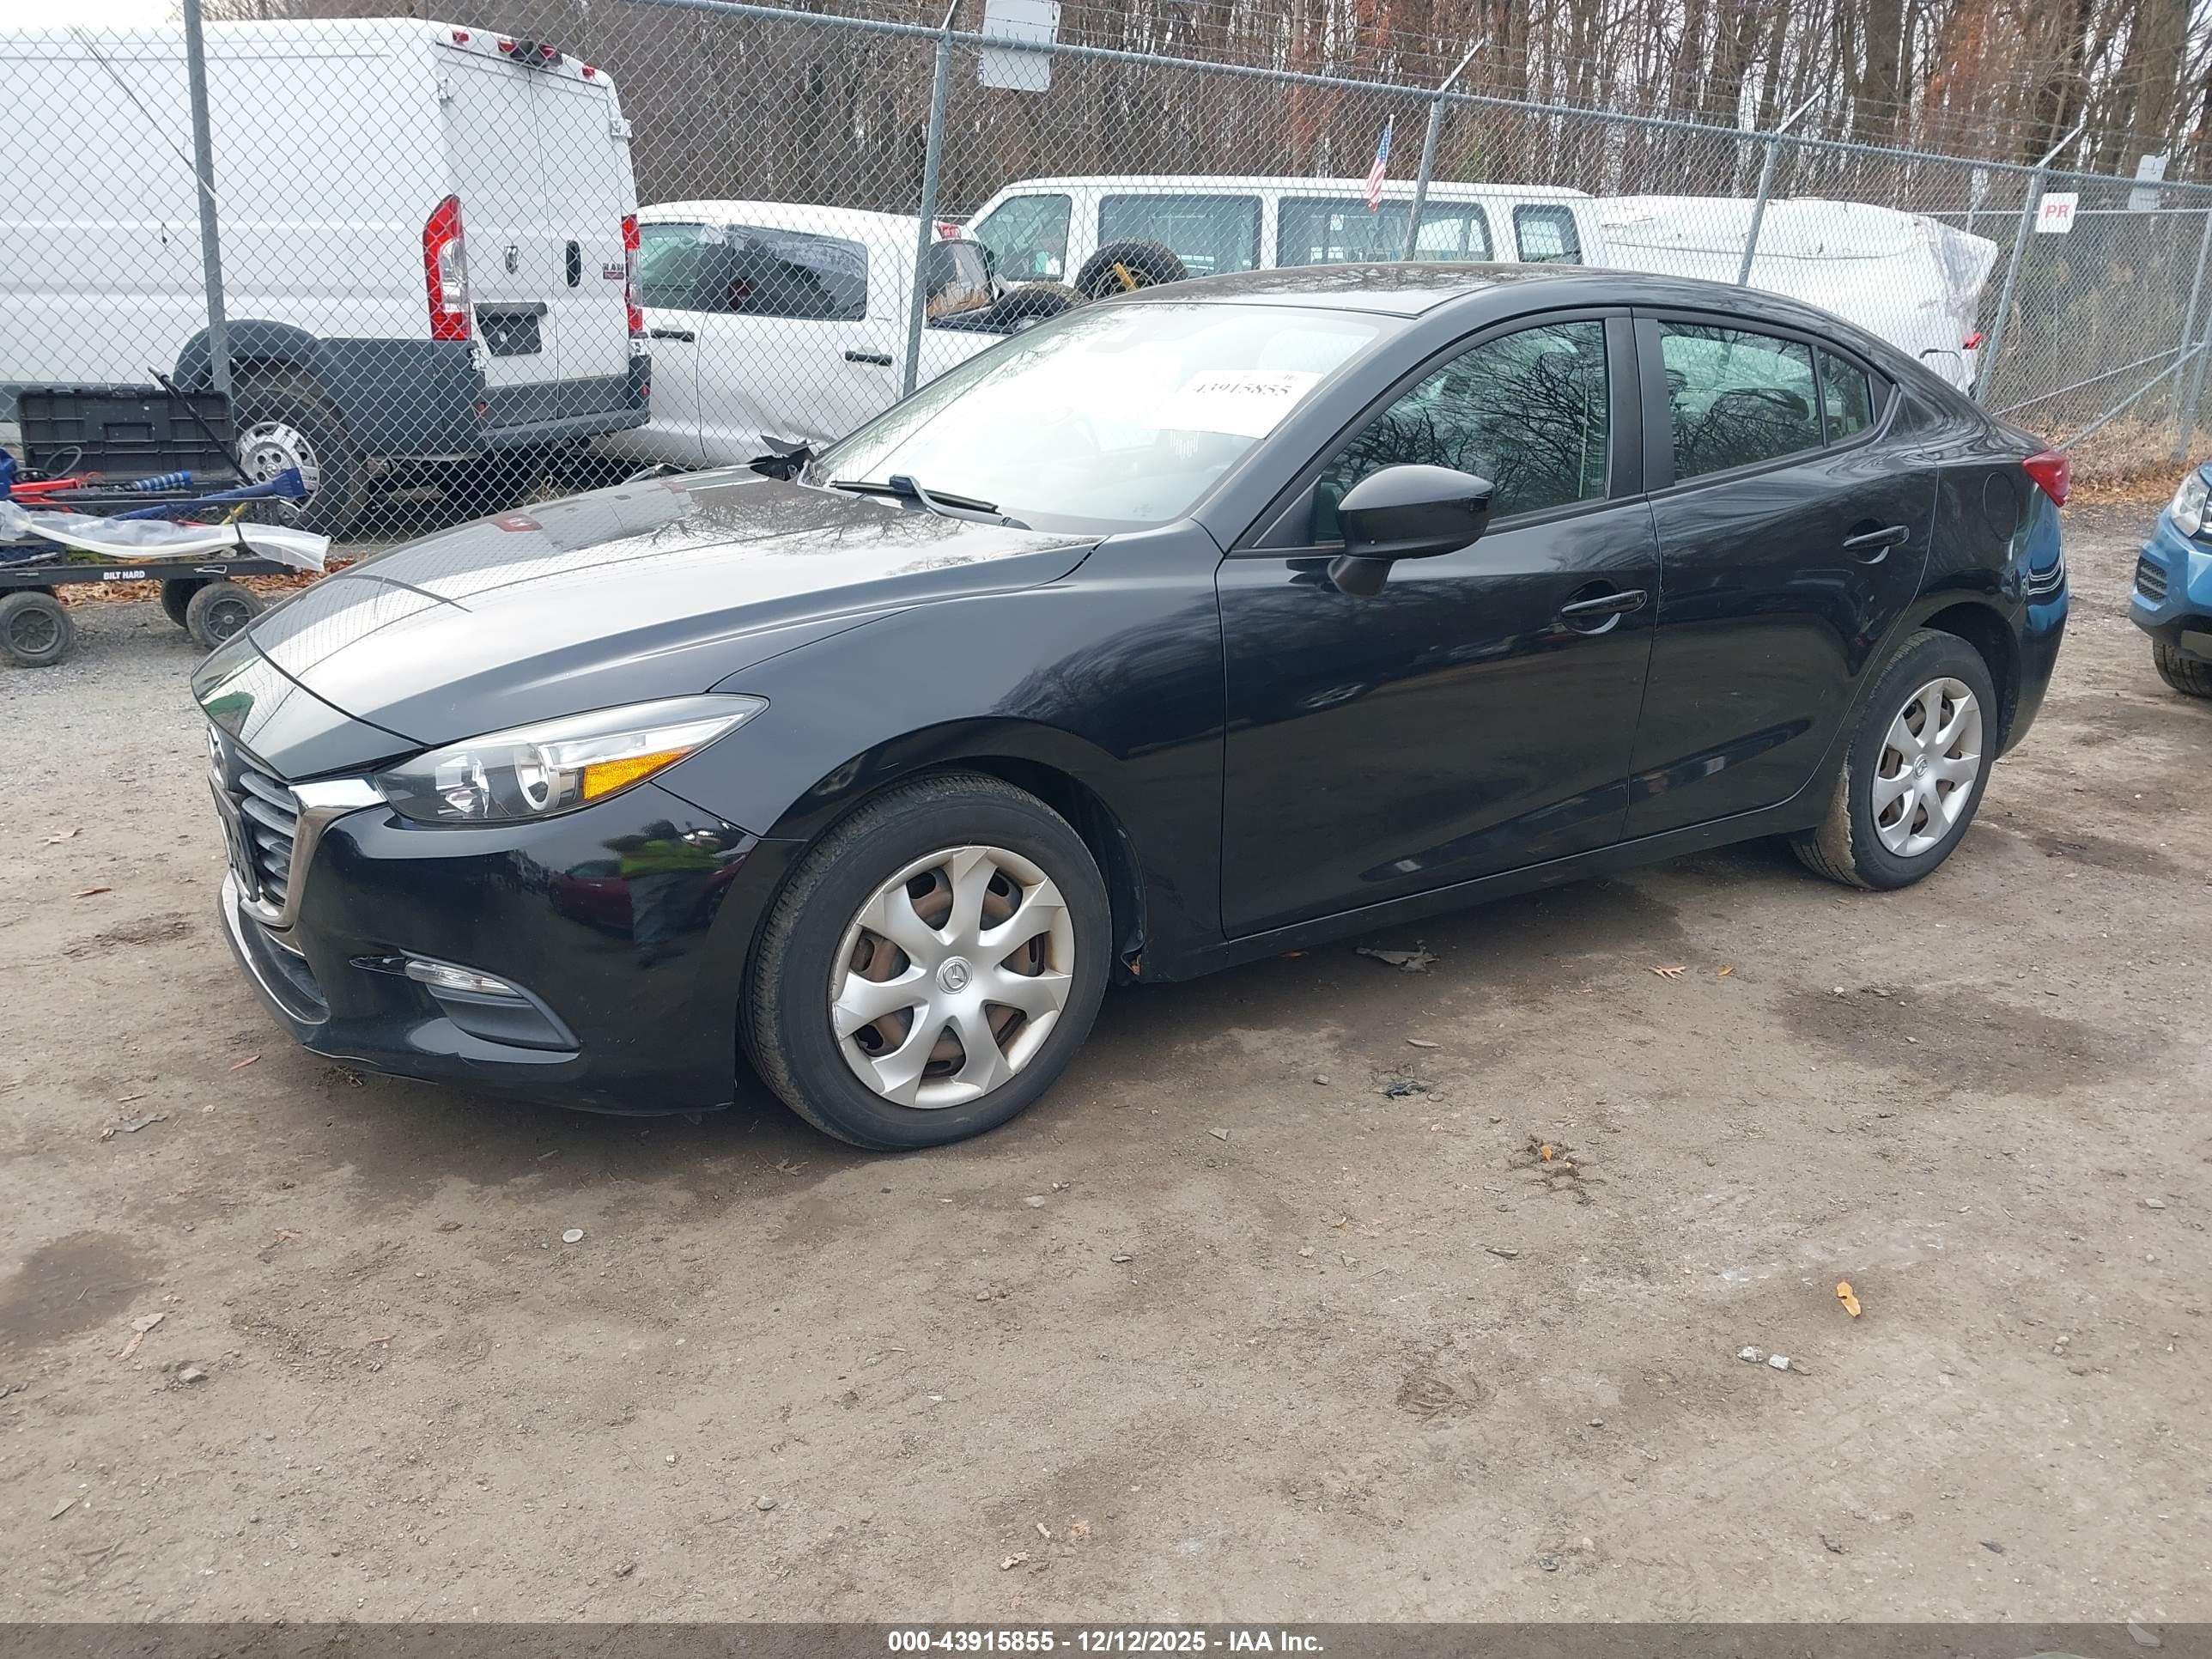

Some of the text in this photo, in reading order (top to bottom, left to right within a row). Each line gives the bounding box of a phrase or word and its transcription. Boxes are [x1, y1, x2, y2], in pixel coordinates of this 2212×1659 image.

[2045, 204, 2069, 219] PR
[103, 570, 146, 580] BILT HARD
